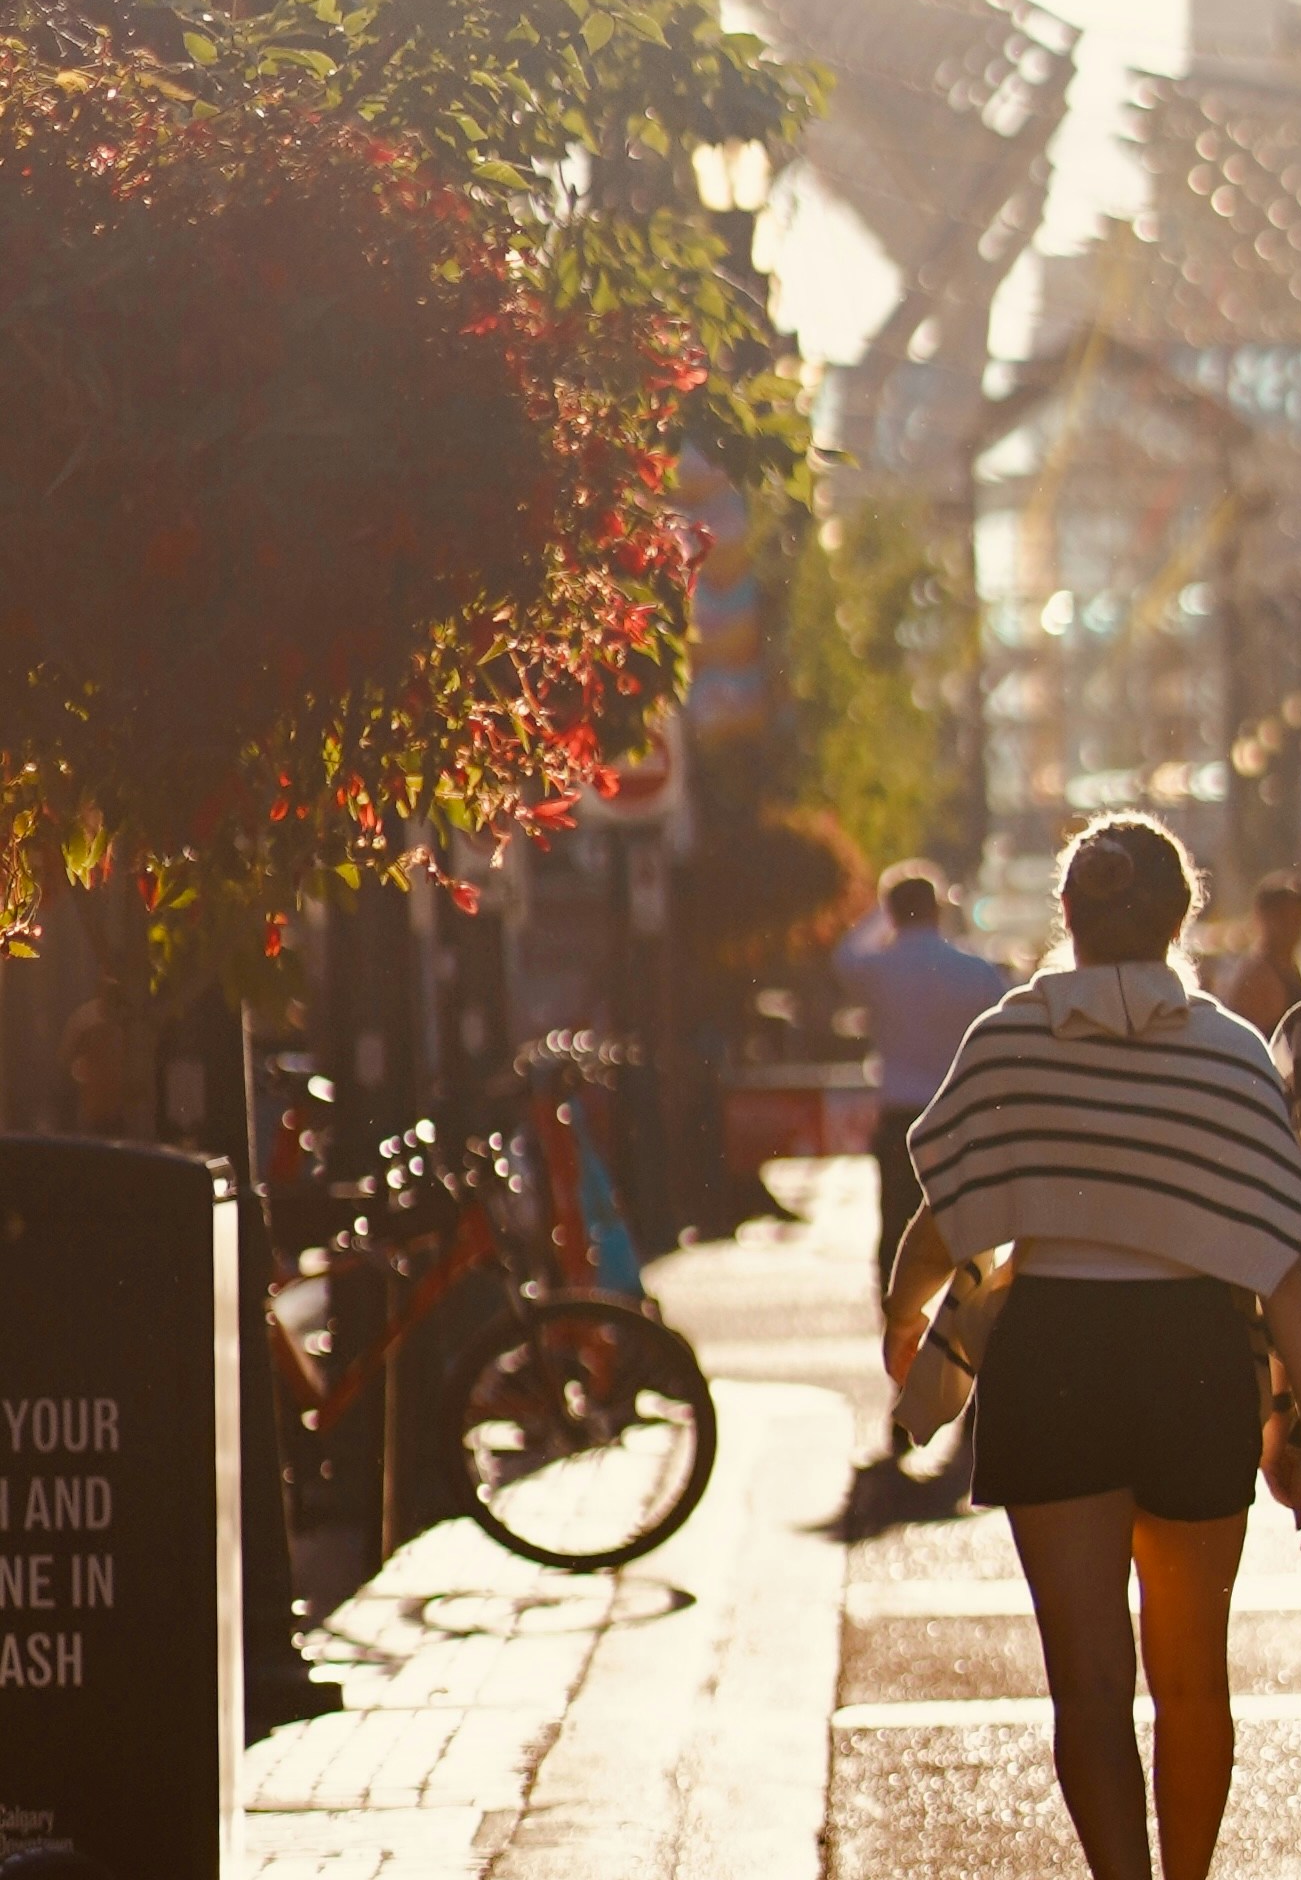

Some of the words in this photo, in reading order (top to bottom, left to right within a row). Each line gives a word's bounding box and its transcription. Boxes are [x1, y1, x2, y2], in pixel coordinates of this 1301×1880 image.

[1, 1397, 120, 1453] YOUR
[22, 1474, 113, 1531] AND
[71, 1553, 115, 1609] IN
[0, 1631, 83, 1687] ASH
